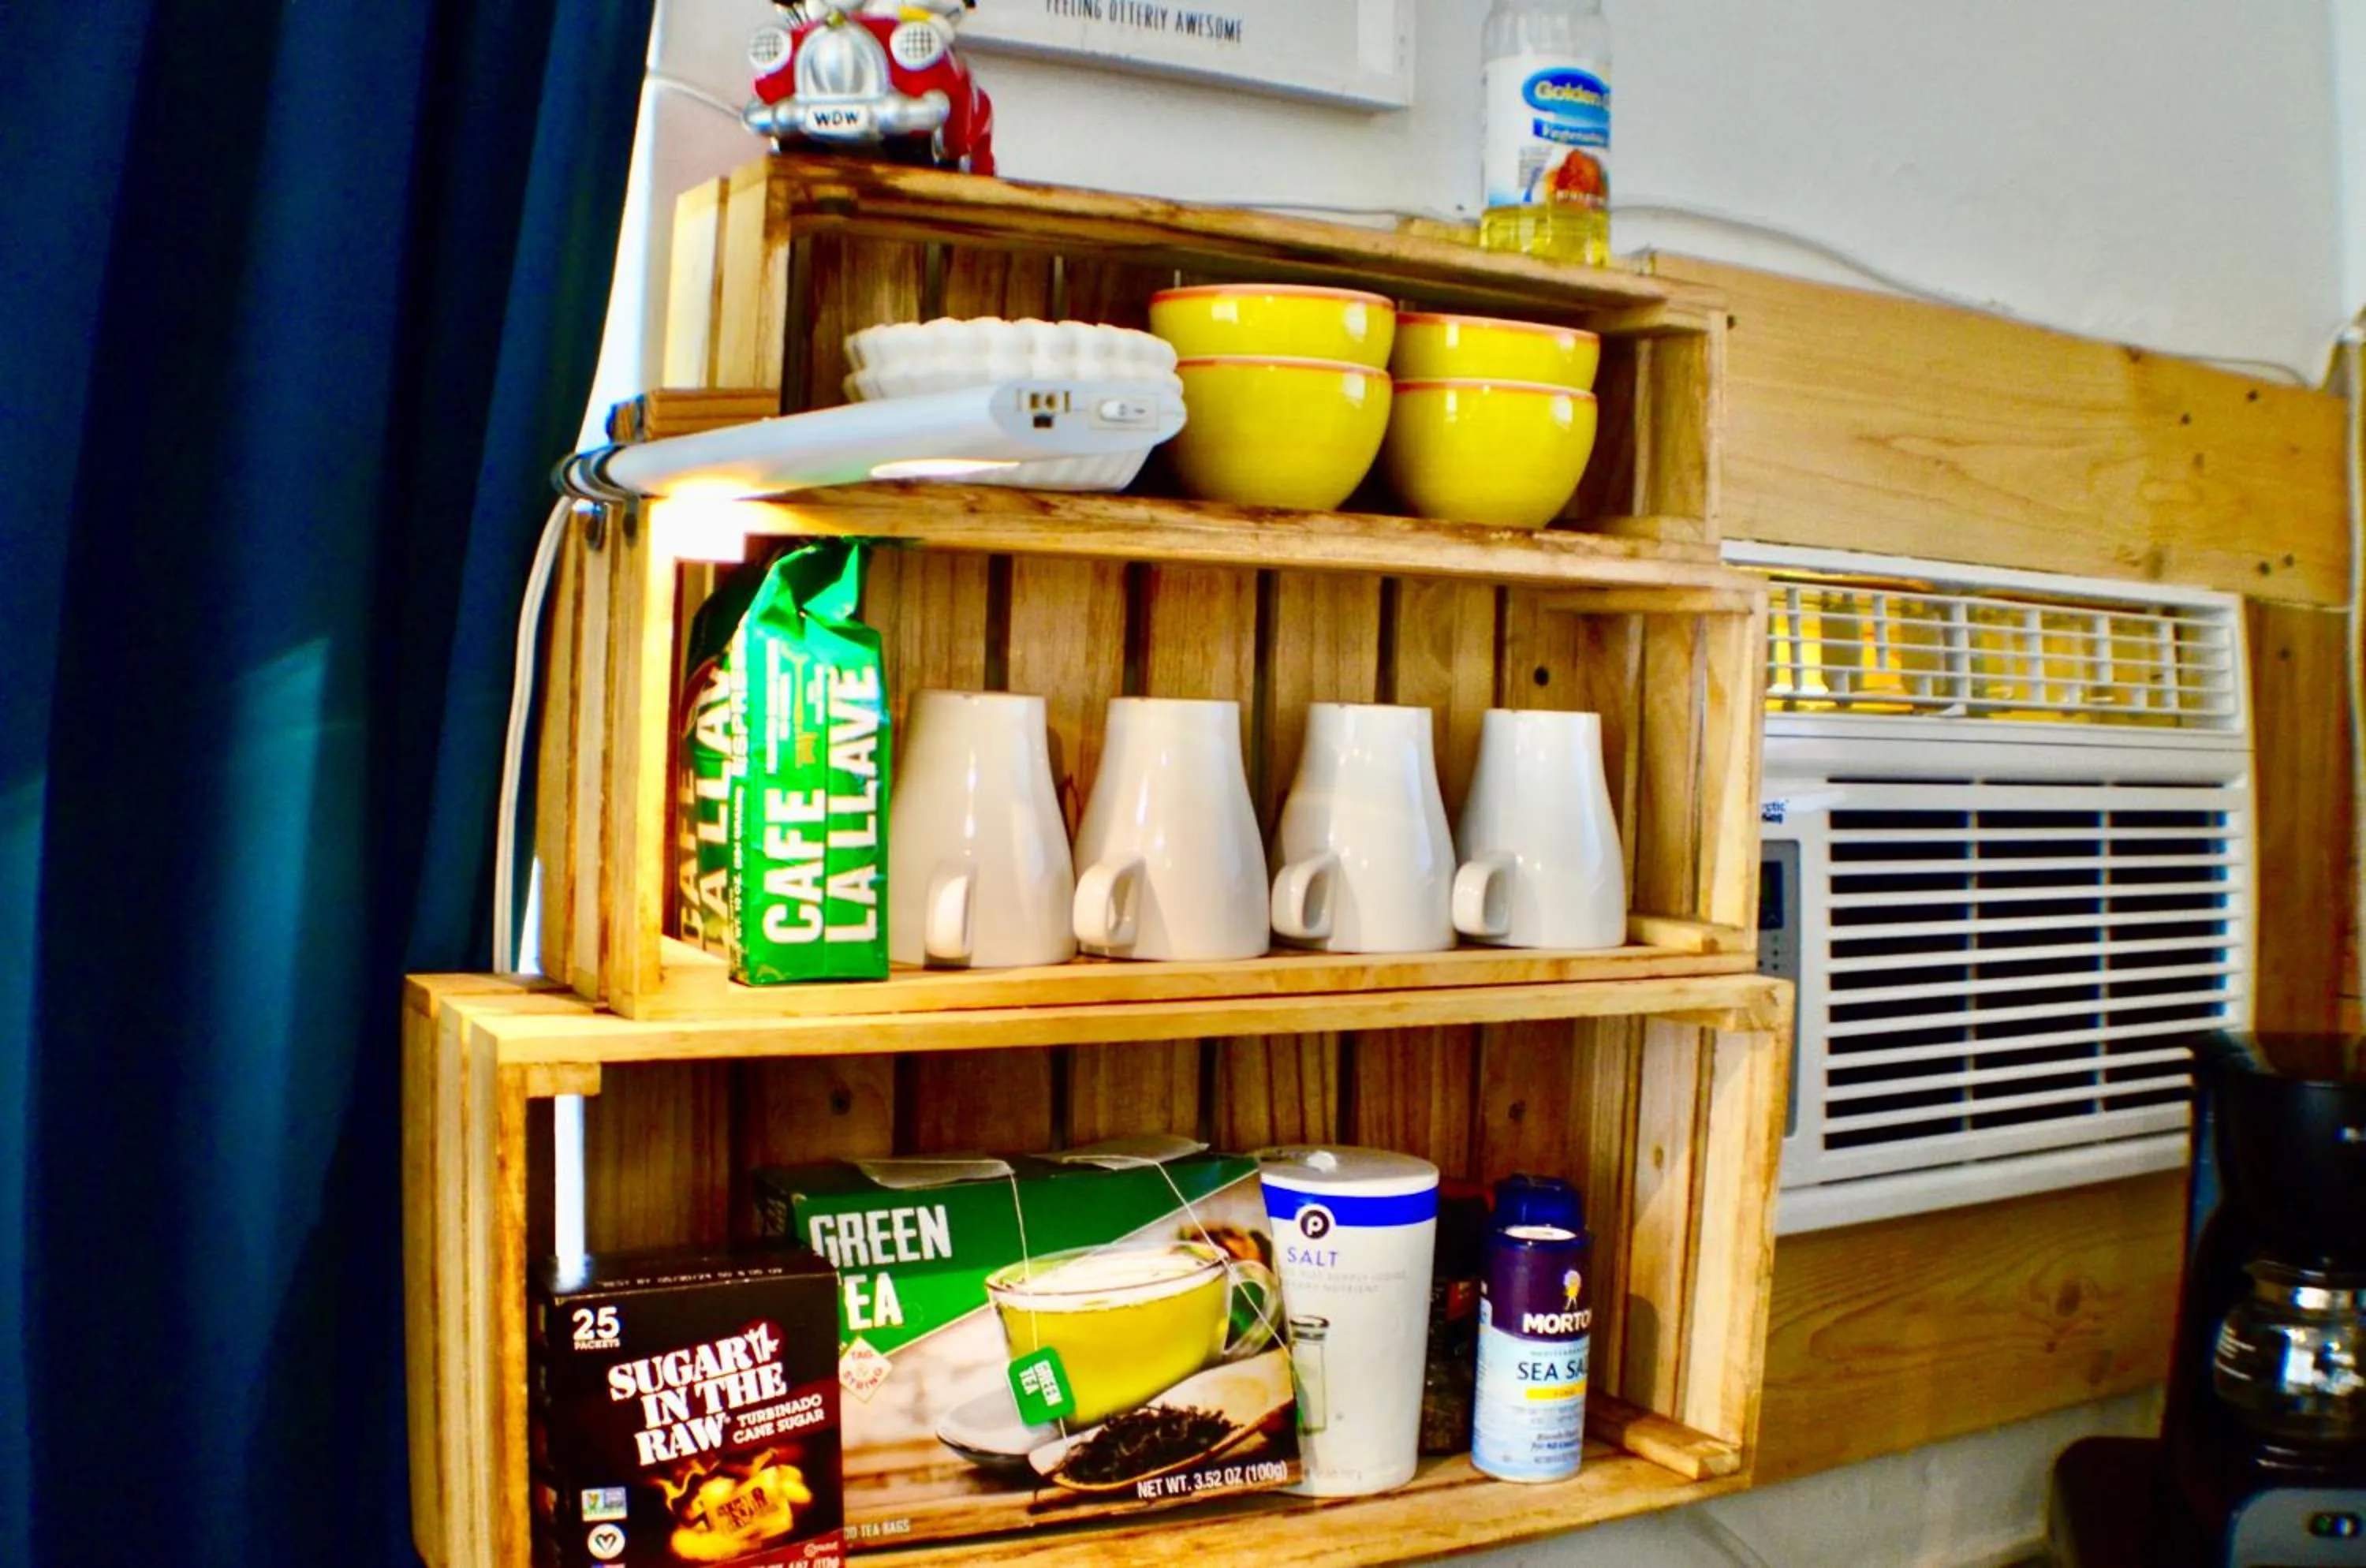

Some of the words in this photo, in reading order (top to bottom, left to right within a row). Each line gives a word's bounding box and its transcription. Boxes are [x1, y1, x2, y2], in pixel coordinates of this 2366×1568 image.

[1176, 11, 1244, 43] AWESOME
[696, 668, 732, 844] LLAV
[827, 665, 880, 848] LLAVE
[763, 789, 826, 944] CAFE
[825, 864, 879, 943] LA
[808, 1204, 953, 1269] GREEN
[1287, 1246, 1338, 1267] SALT
[572, 1305, 620, 1339] 25
[836, 1271, 905, 1331] EA
[1523, 1309, 1592, 1334] MORTO
[608, 1335, 753, 1402] SUGAR
[1517, 1362, 1559, 1382] SEA
[1566, 1357, 1588, 1380] SA
[640, 1386, 691, 1430] IN
[694, 1362, 787, 1415] THE
[737, 1394, 823, 1428] TURBINADO
[733, 1421, 775, 1445] CANE
[777, 1409, 825, 1433] SUGAR
[1136, 1477, 1163, 1499] NET
[1165, 1475, 1192, 1494] WT.
[1193, 1469, 1222, 1490] 3.52
[1224, 1465, 1244, 1486] OZ
[1245, 1459, 1289, 1485] (100g)
